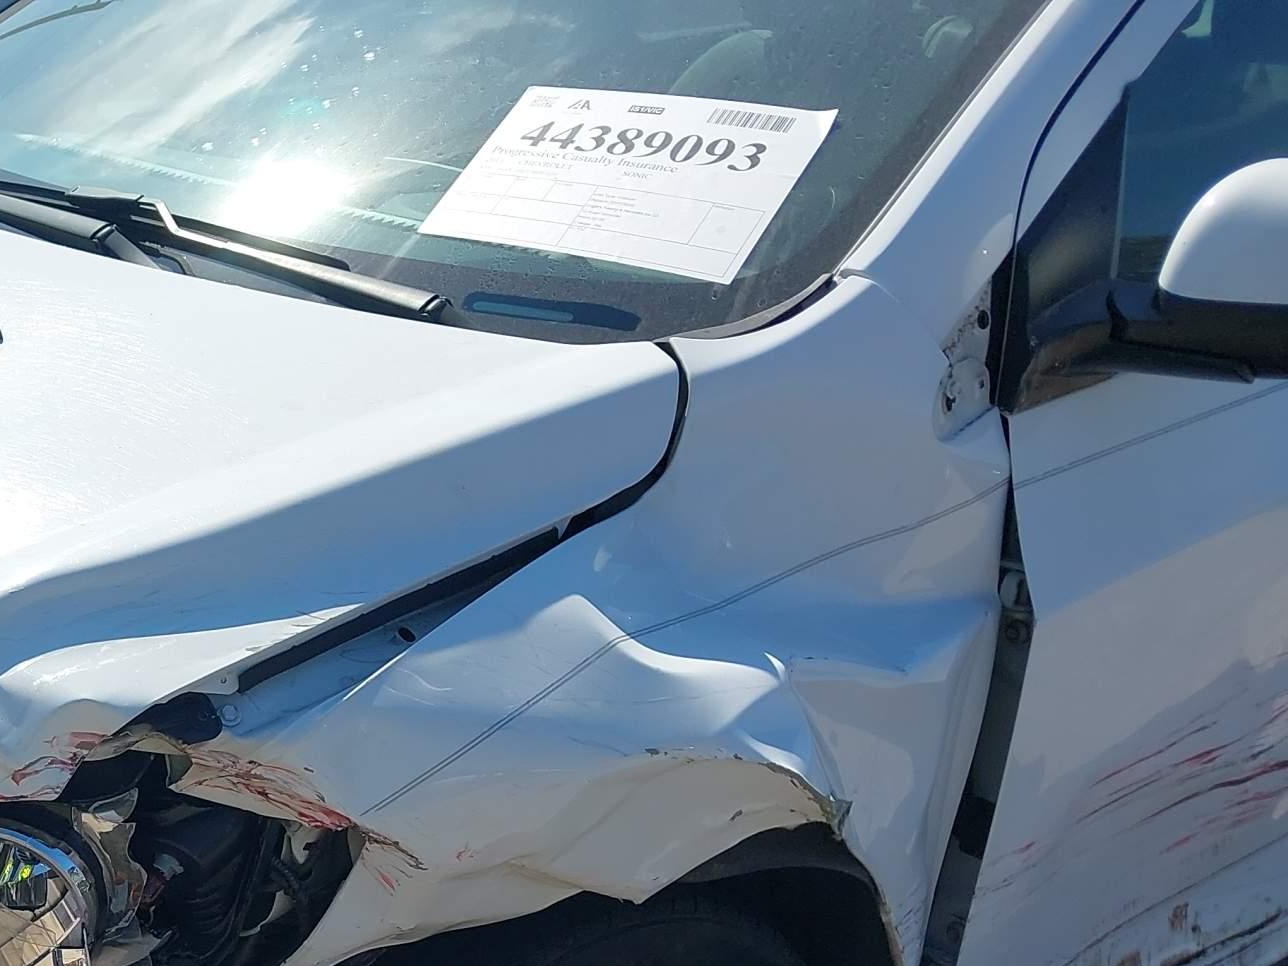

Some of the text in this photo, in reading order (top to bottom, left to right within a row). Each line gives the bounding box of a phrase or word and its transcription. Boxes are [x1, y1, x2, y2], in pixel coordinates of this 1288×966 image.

[492, 145, 679, 173] Progressive Casualty Insurance
[520, 121, 767, 172] 44389093
